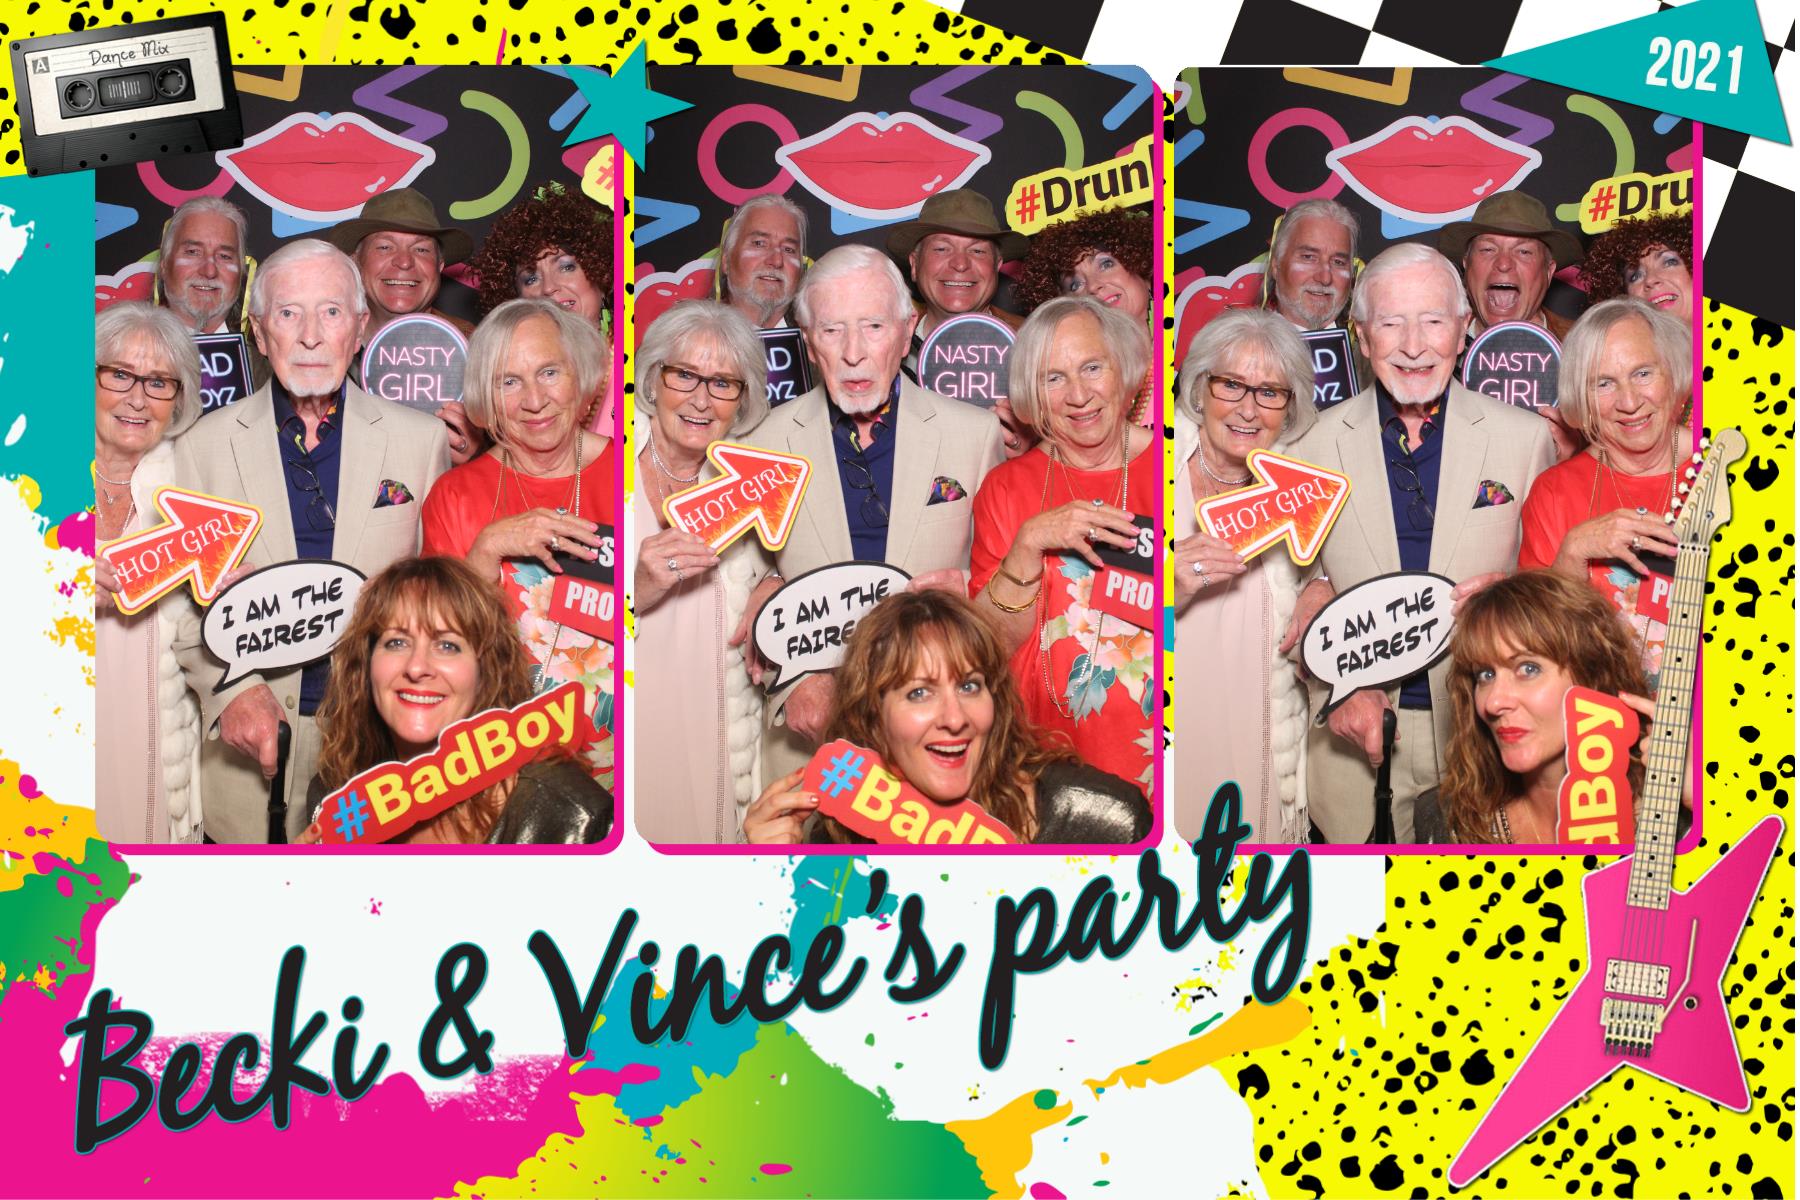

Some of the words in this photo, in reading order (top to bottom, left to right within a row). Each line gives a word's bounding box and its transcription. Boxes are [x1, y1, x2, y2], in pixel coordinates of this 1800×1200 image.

[1016, 144, 1154, 225] #Drun
[379, 345, 457, 367] NASTY
[935, 344, 1009, 365] NASTY
[1478, 352, 1552, 373] NASTY
[379, 373, 455, 401] GIRL
[934, 371, 1008, 399] GIRL
[1312, 382, 1343, 403] YZ
[1478, 378, 1550, 407] GIRL
[684, 488, 739, 534] HOT
[740, 463, 799, 502] GIRL
[1214, 498, 1272, 540] HOT
[1275, 477, 1338, 515] GIRL
[117, 538, 176, 584] HOT
[181, 512, 247, 555] GIRL
[222, 605, 235, 630] I
[245, 593, 281, 623] AM
[291, 577, 344, 611] THE
[564, 581, 614, 622] PRO
[773, 608, 785, 633] I
[796, 595, 830, 625] AM
[840, 578, 890, 612] THE
[1105, 569, 1154, 611] PRO
[236, 608, 344, 659] FAIREST
[787, 620, 856, 661] FAIRE
[1320, 626, 1333, 651] I
[1344, 609, 1377, 642] AM
[1385, 586, 1436, 624] THE
[1336, 618, 1439, 678] FAIREST
[333, 690, 577, 843] #BadBoy
